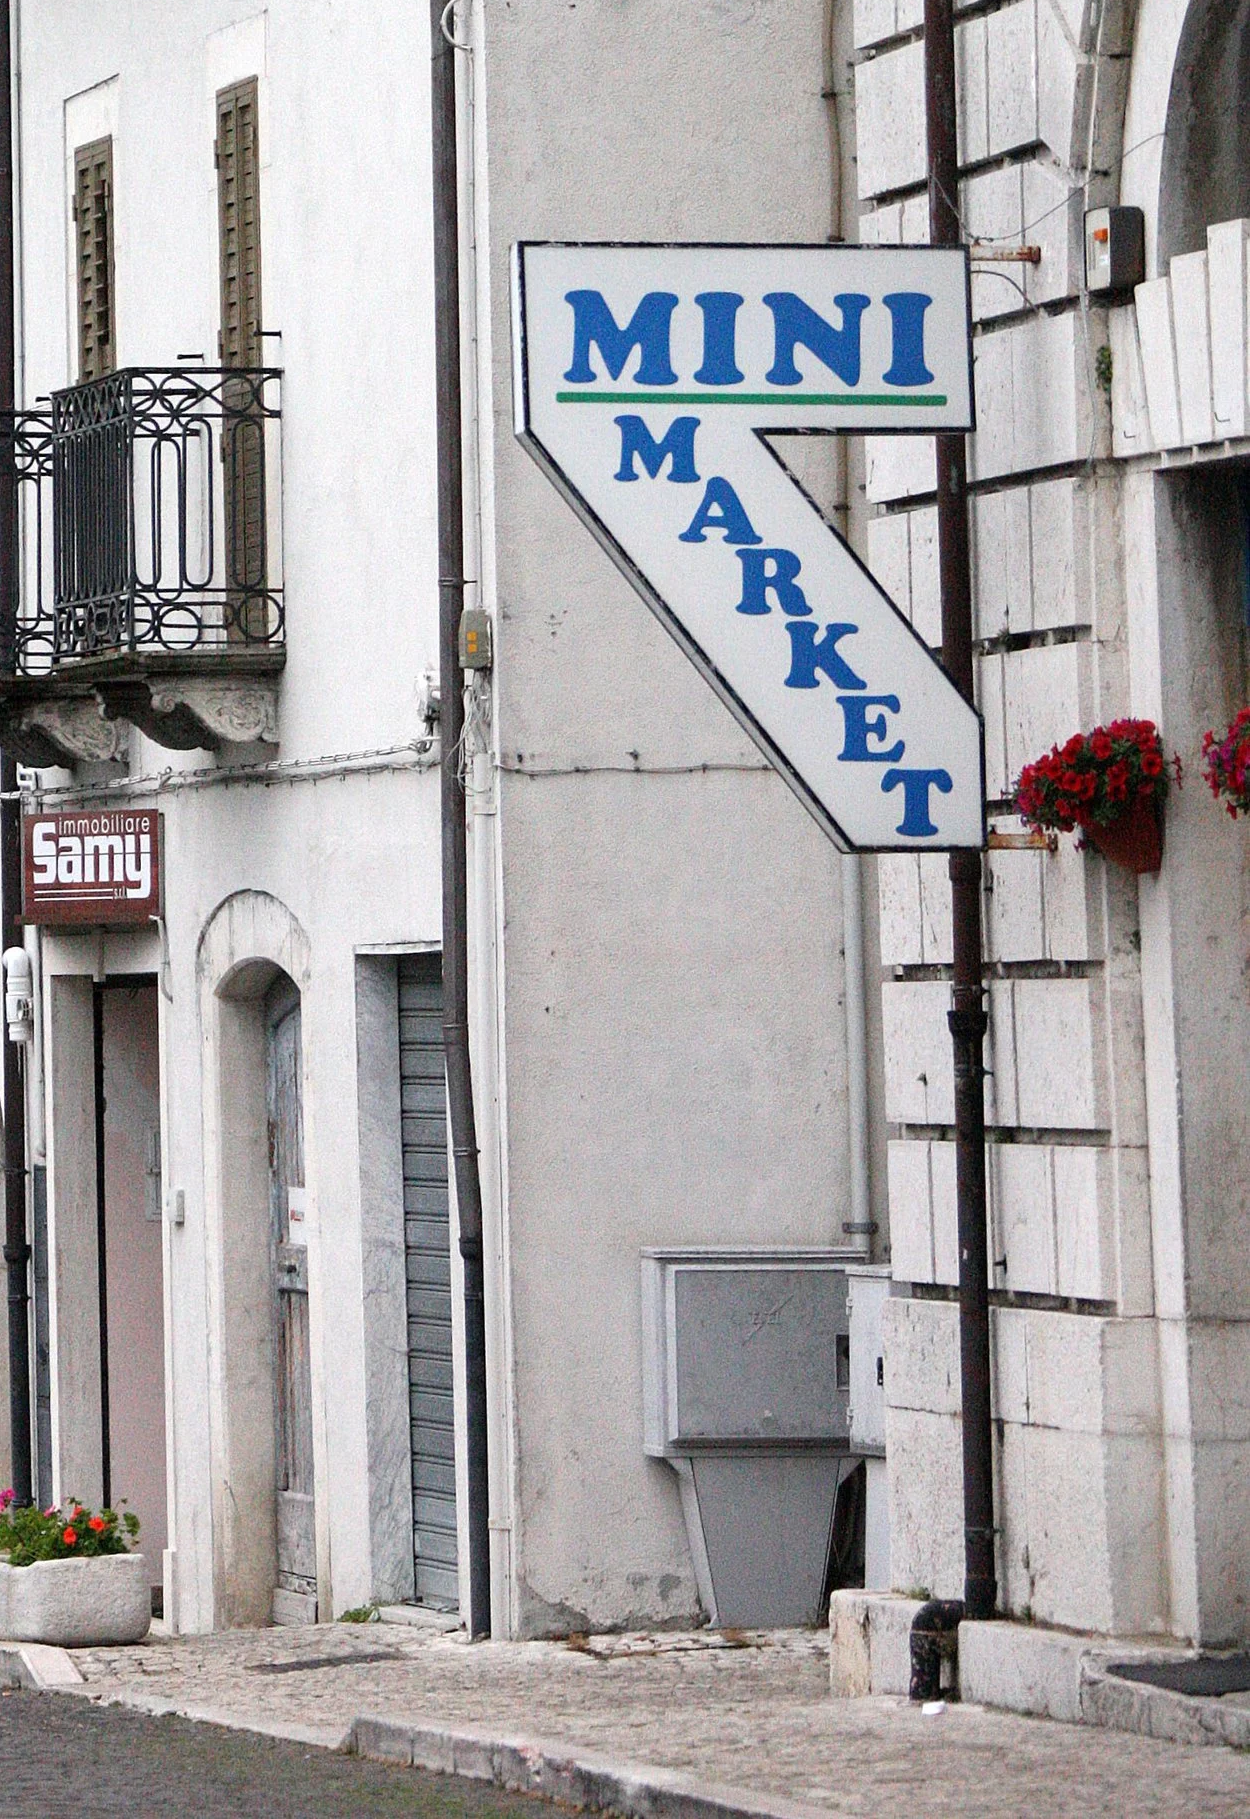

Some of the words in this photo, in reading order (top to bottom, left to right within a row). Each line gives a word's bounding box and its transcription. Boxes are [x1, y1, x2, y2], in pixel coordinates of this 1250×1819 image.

[563, 289, 936, 387] MINI
[613, 414, 954, 839] MARKET
[32, 820, 152, 899] Samy
[58, 814, 150, 835] immobiliare
